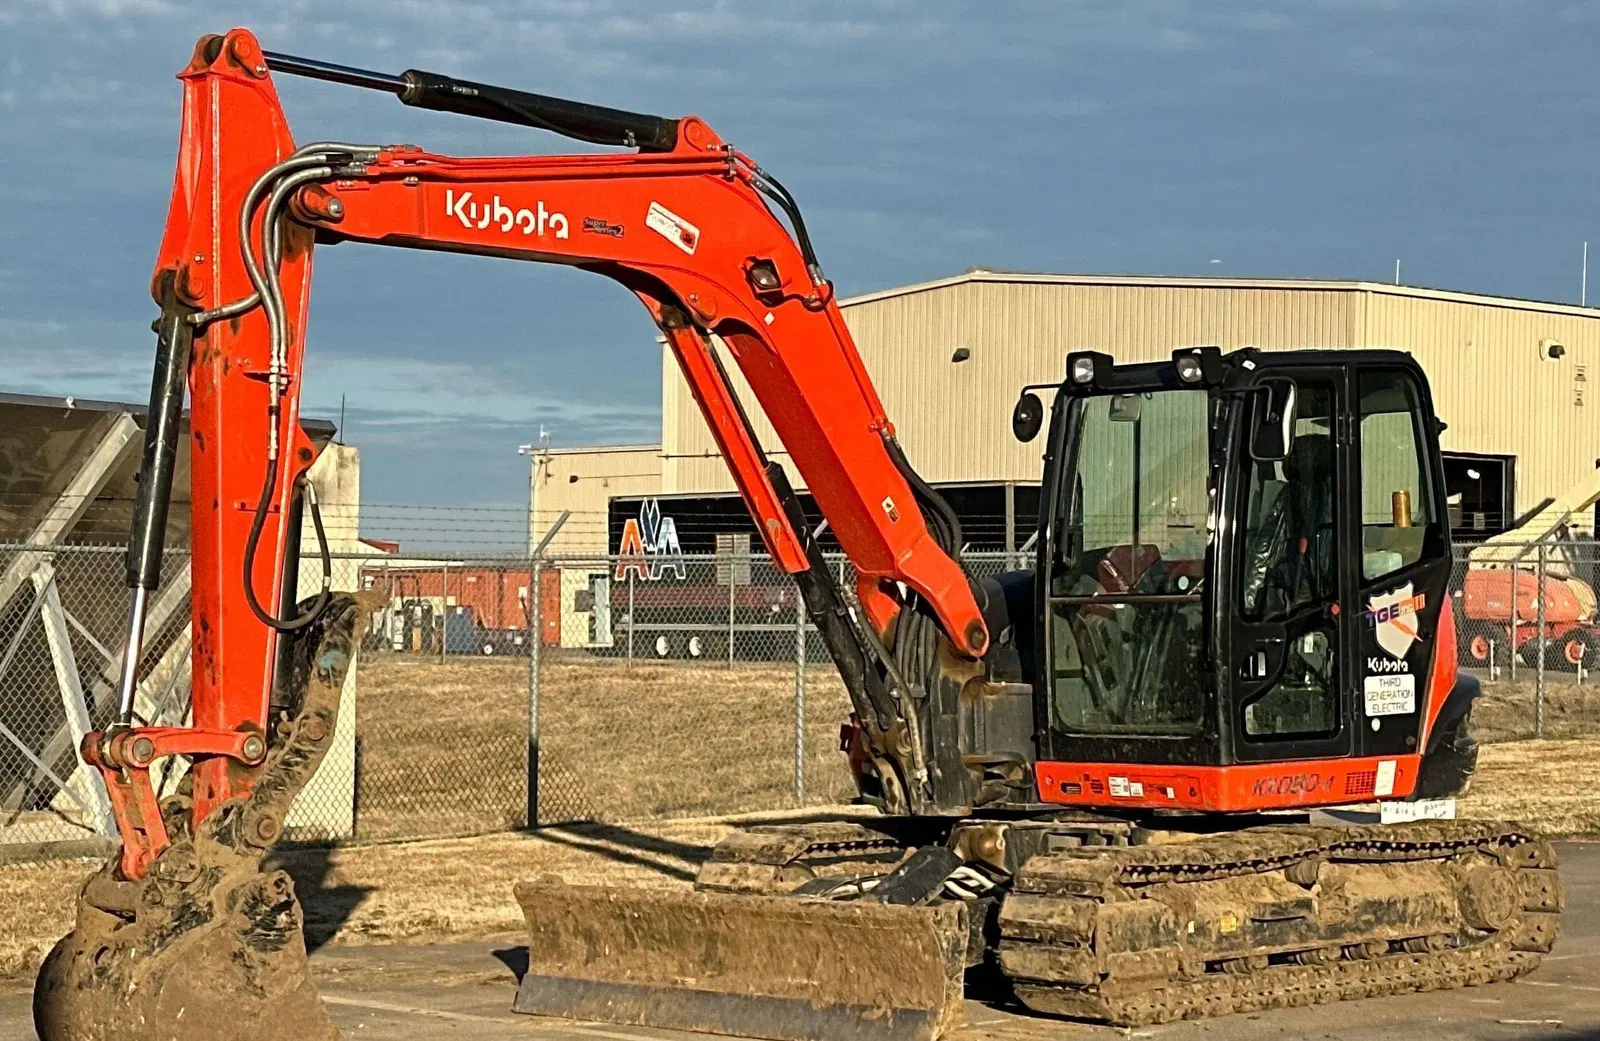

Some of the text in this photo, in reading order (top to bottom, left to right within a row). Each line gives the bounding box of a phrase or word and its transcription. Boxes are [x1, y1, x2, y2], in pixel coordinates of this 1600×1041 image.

[446, 189, 569, 239] Kubota
[1367, 657, 1409, 673] Kubota
[1379, 678, 1401, 688] THIRD
[1372, 701, 1408, 713] ELECTRIC
